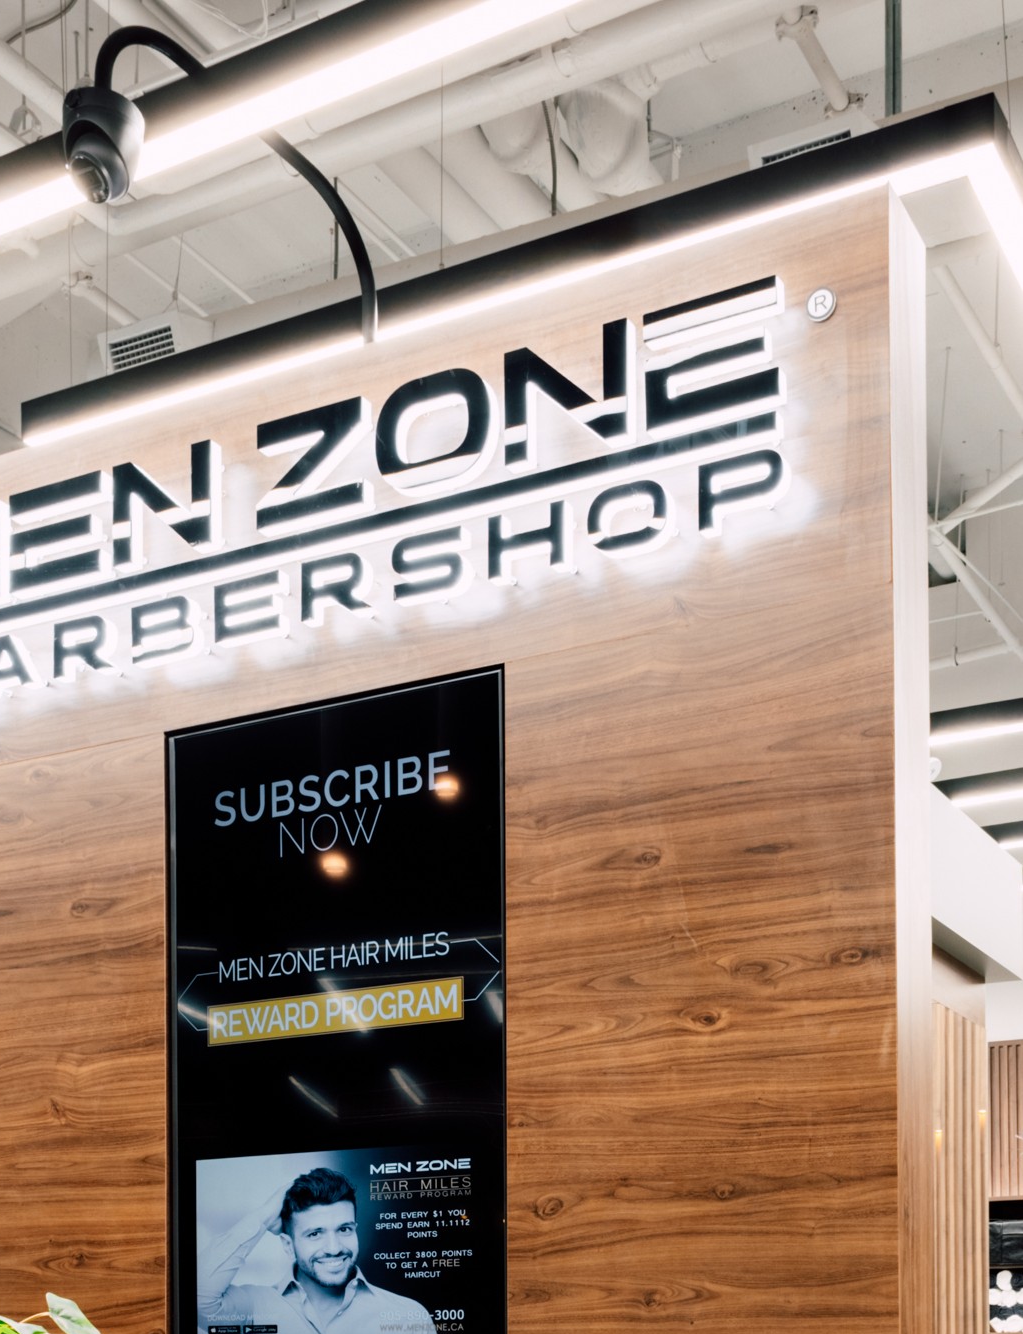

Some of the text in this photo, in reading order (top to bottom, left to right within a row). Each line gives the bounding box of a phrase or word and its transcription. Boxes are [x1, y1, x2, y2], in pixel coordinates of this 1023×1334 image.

[257, 276, 785, 534] ZONE
[214, 749, 451, 827] SUBSCRIBE
[280, 804, 382, 857] NOW
[218, 931, 450, 983] MEN ZONE HAIR MILES
[212, 984, 458, 1039] REWARD PROGRAM
[370, 1158, 471, 1175] MEN ZONE
[370, 1177, 471, 1193] HAIR MILES
[370, 1189, 472, 1201] REWARD PROGRAM
[379, 1209, 466, 1220] FOR EVERY $1 YOU
[375, 1219, 470, 1230] SPEND EARN 11.1112
[407, 1230, 438, 1238] POINTS
[374, 1252, 410, 1260] COLLECT
[441, 1249, 473, 1257] POINTS
[401, 1261, 418, 1269] GET
[432, 1258, 460, 1267] FREE
